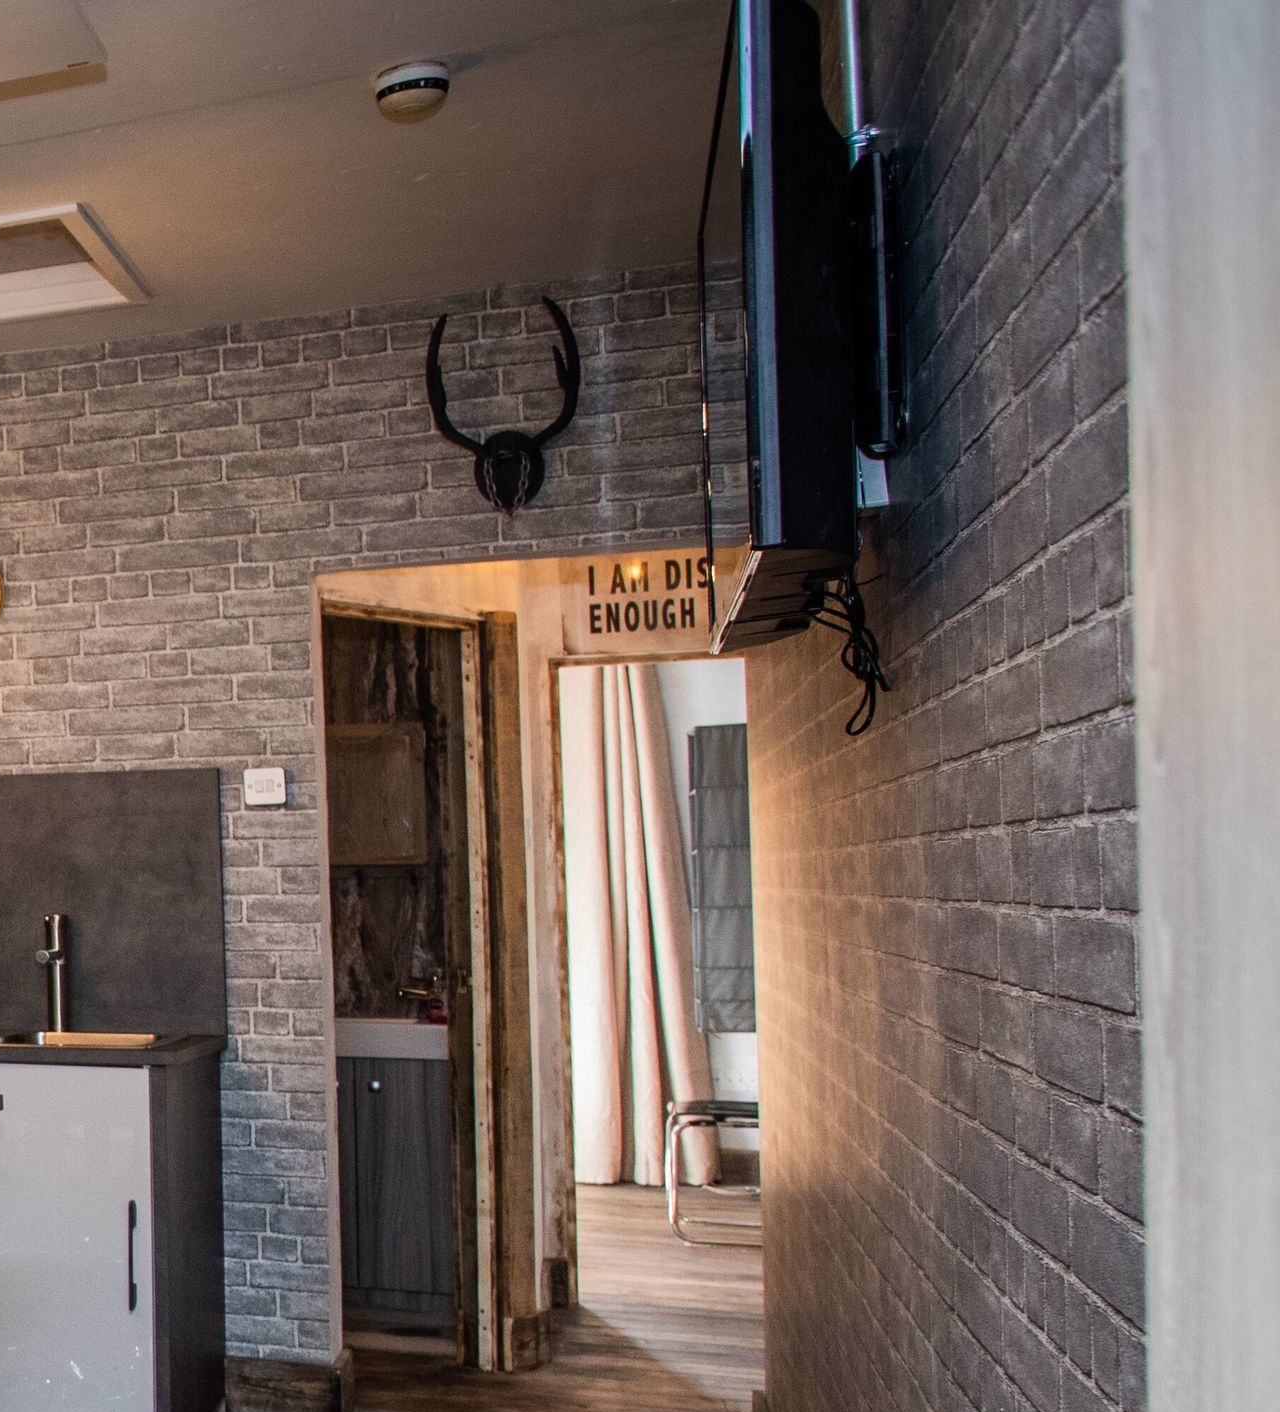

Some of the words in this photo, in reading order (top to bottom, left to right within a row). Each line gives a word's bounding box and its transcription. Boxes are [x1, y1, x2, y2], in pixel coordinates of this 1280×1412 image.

[588, 566, 595, 595] I
[611, 562, 649, 594] AM
[590, 598, 695, 633] ENOUGH
